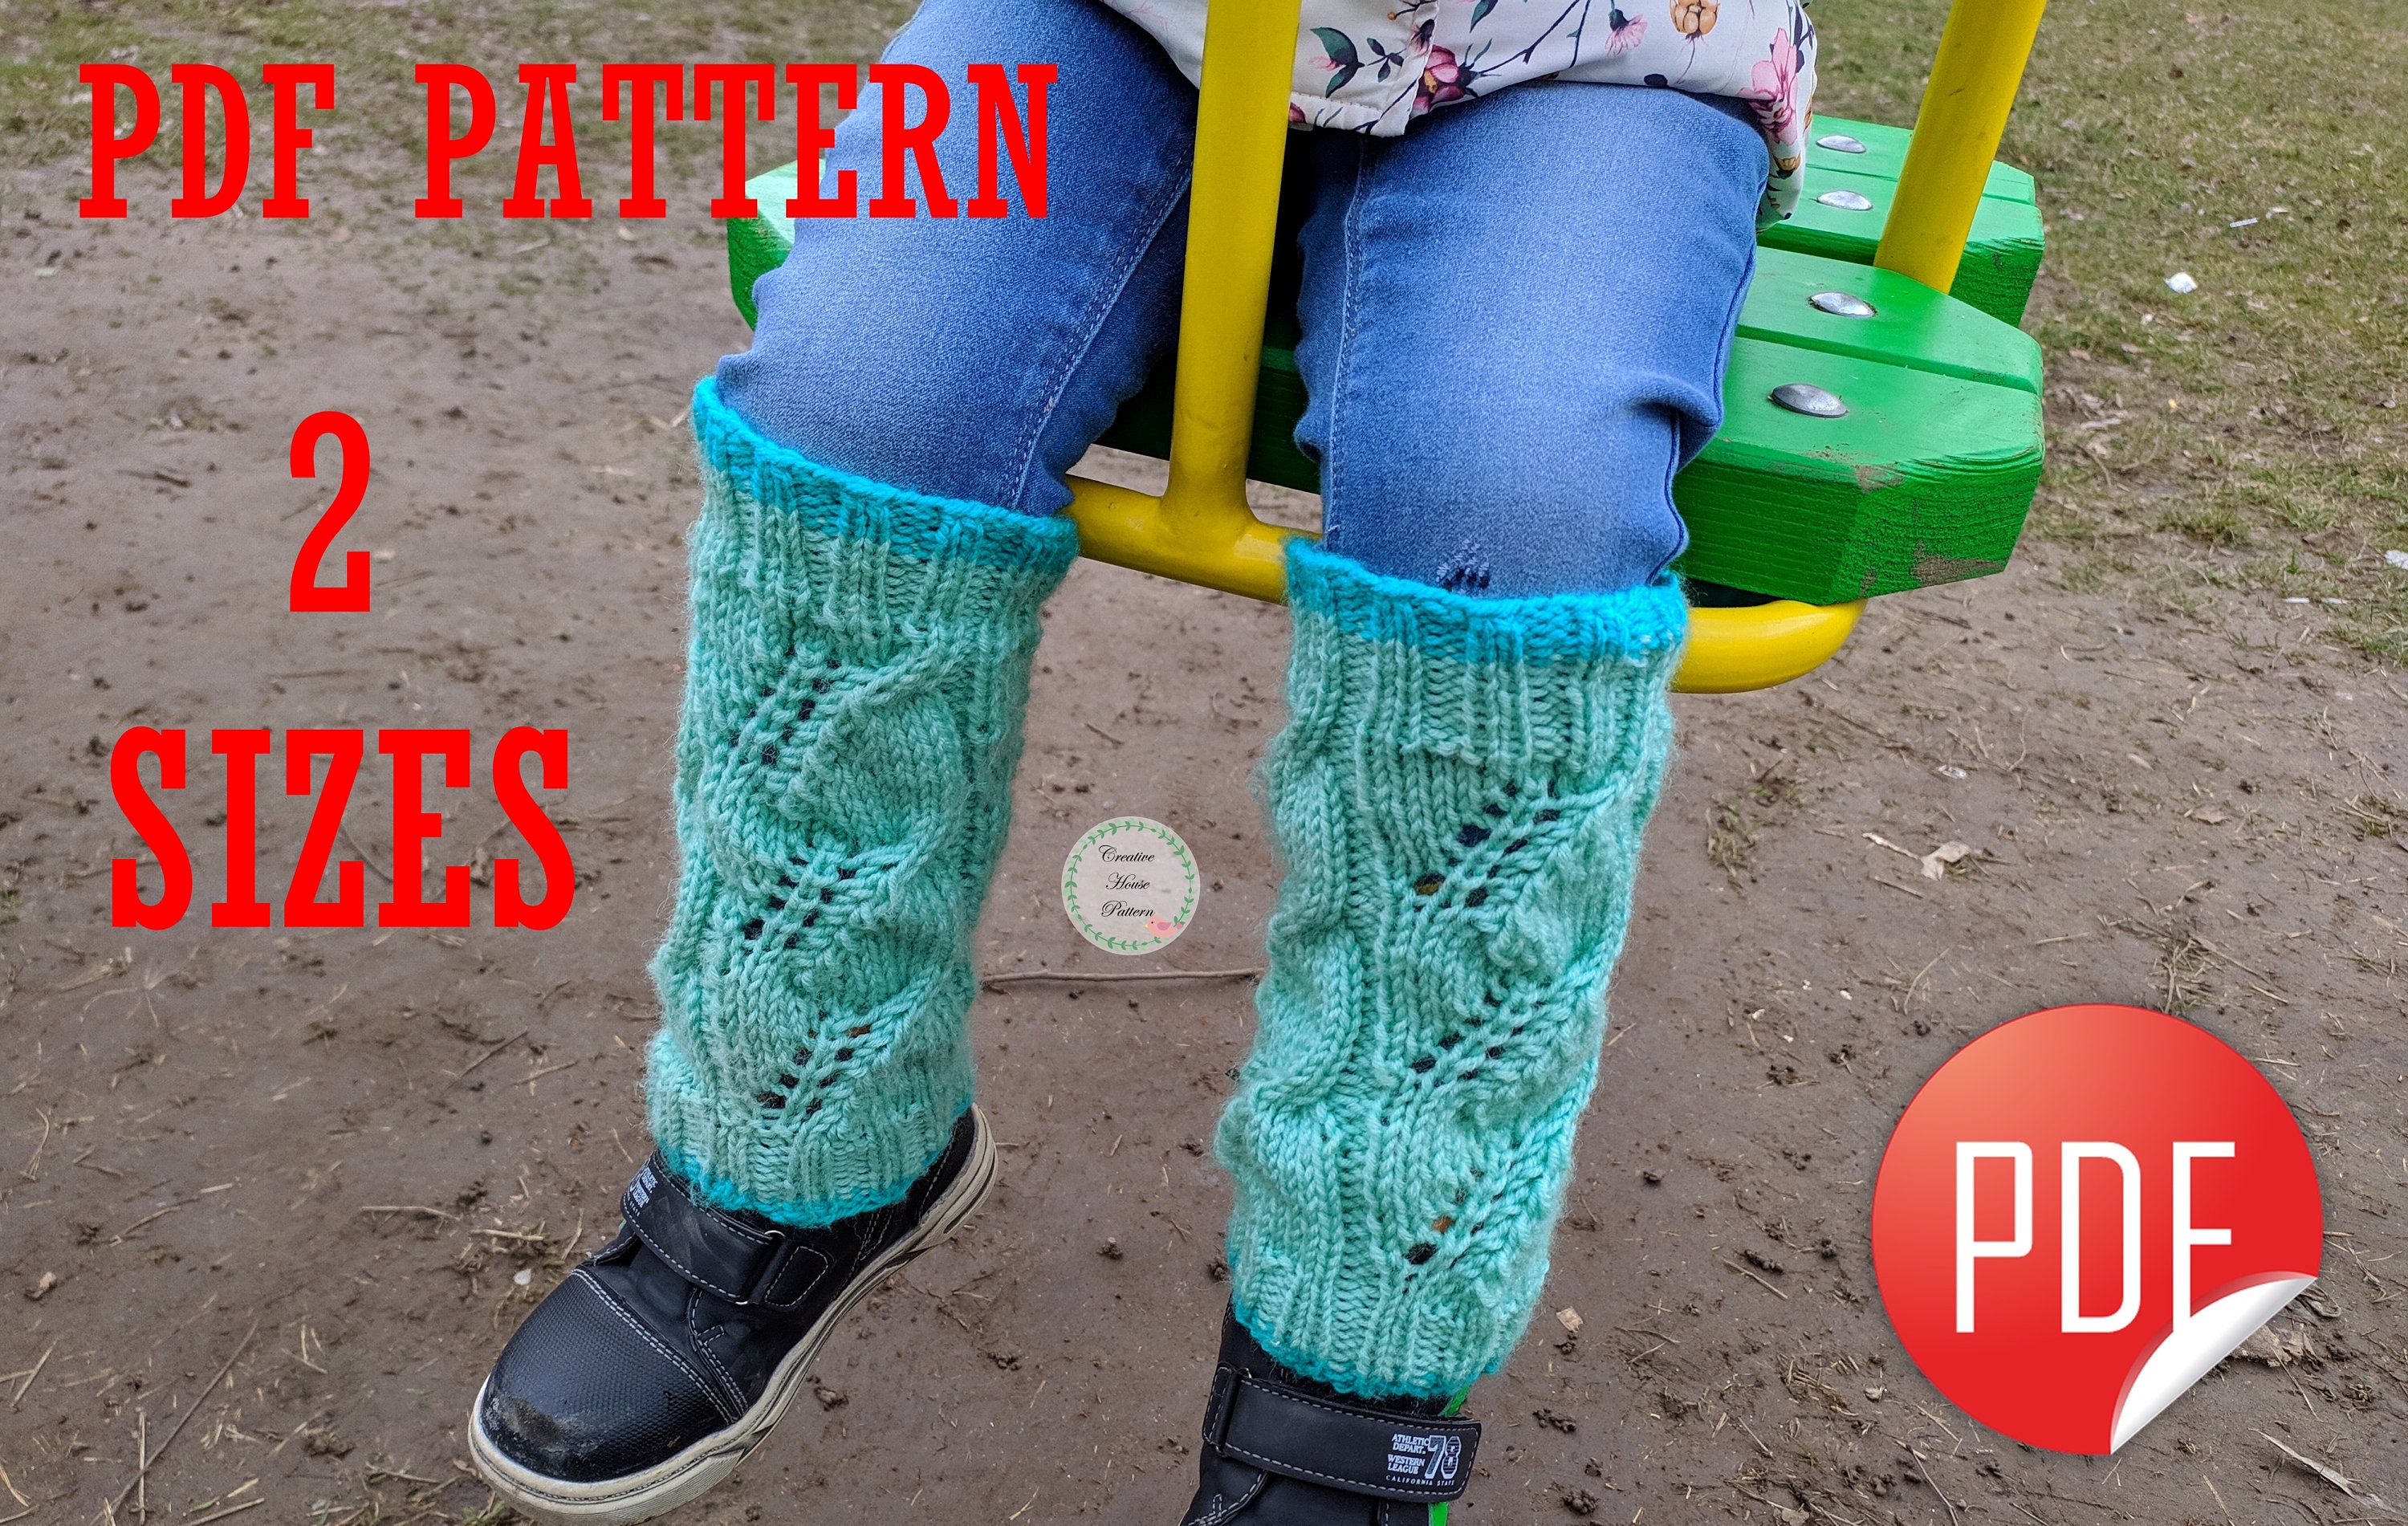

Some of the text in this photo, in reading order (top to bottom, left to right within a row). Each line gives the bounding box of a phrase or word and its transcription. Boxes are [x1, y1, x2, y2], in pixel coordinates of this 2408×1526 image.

[1391, 1433, 1430, 1447] ATHLETIC
[1393, 1443, 1426, 1455] DEPART.
[1387, 1454, 1426, 1467] WESTERN
[1387, 1463, 1419, 1475] LEAGUE
[1385, 1475, 1433, 1486] CALIFORNIA
